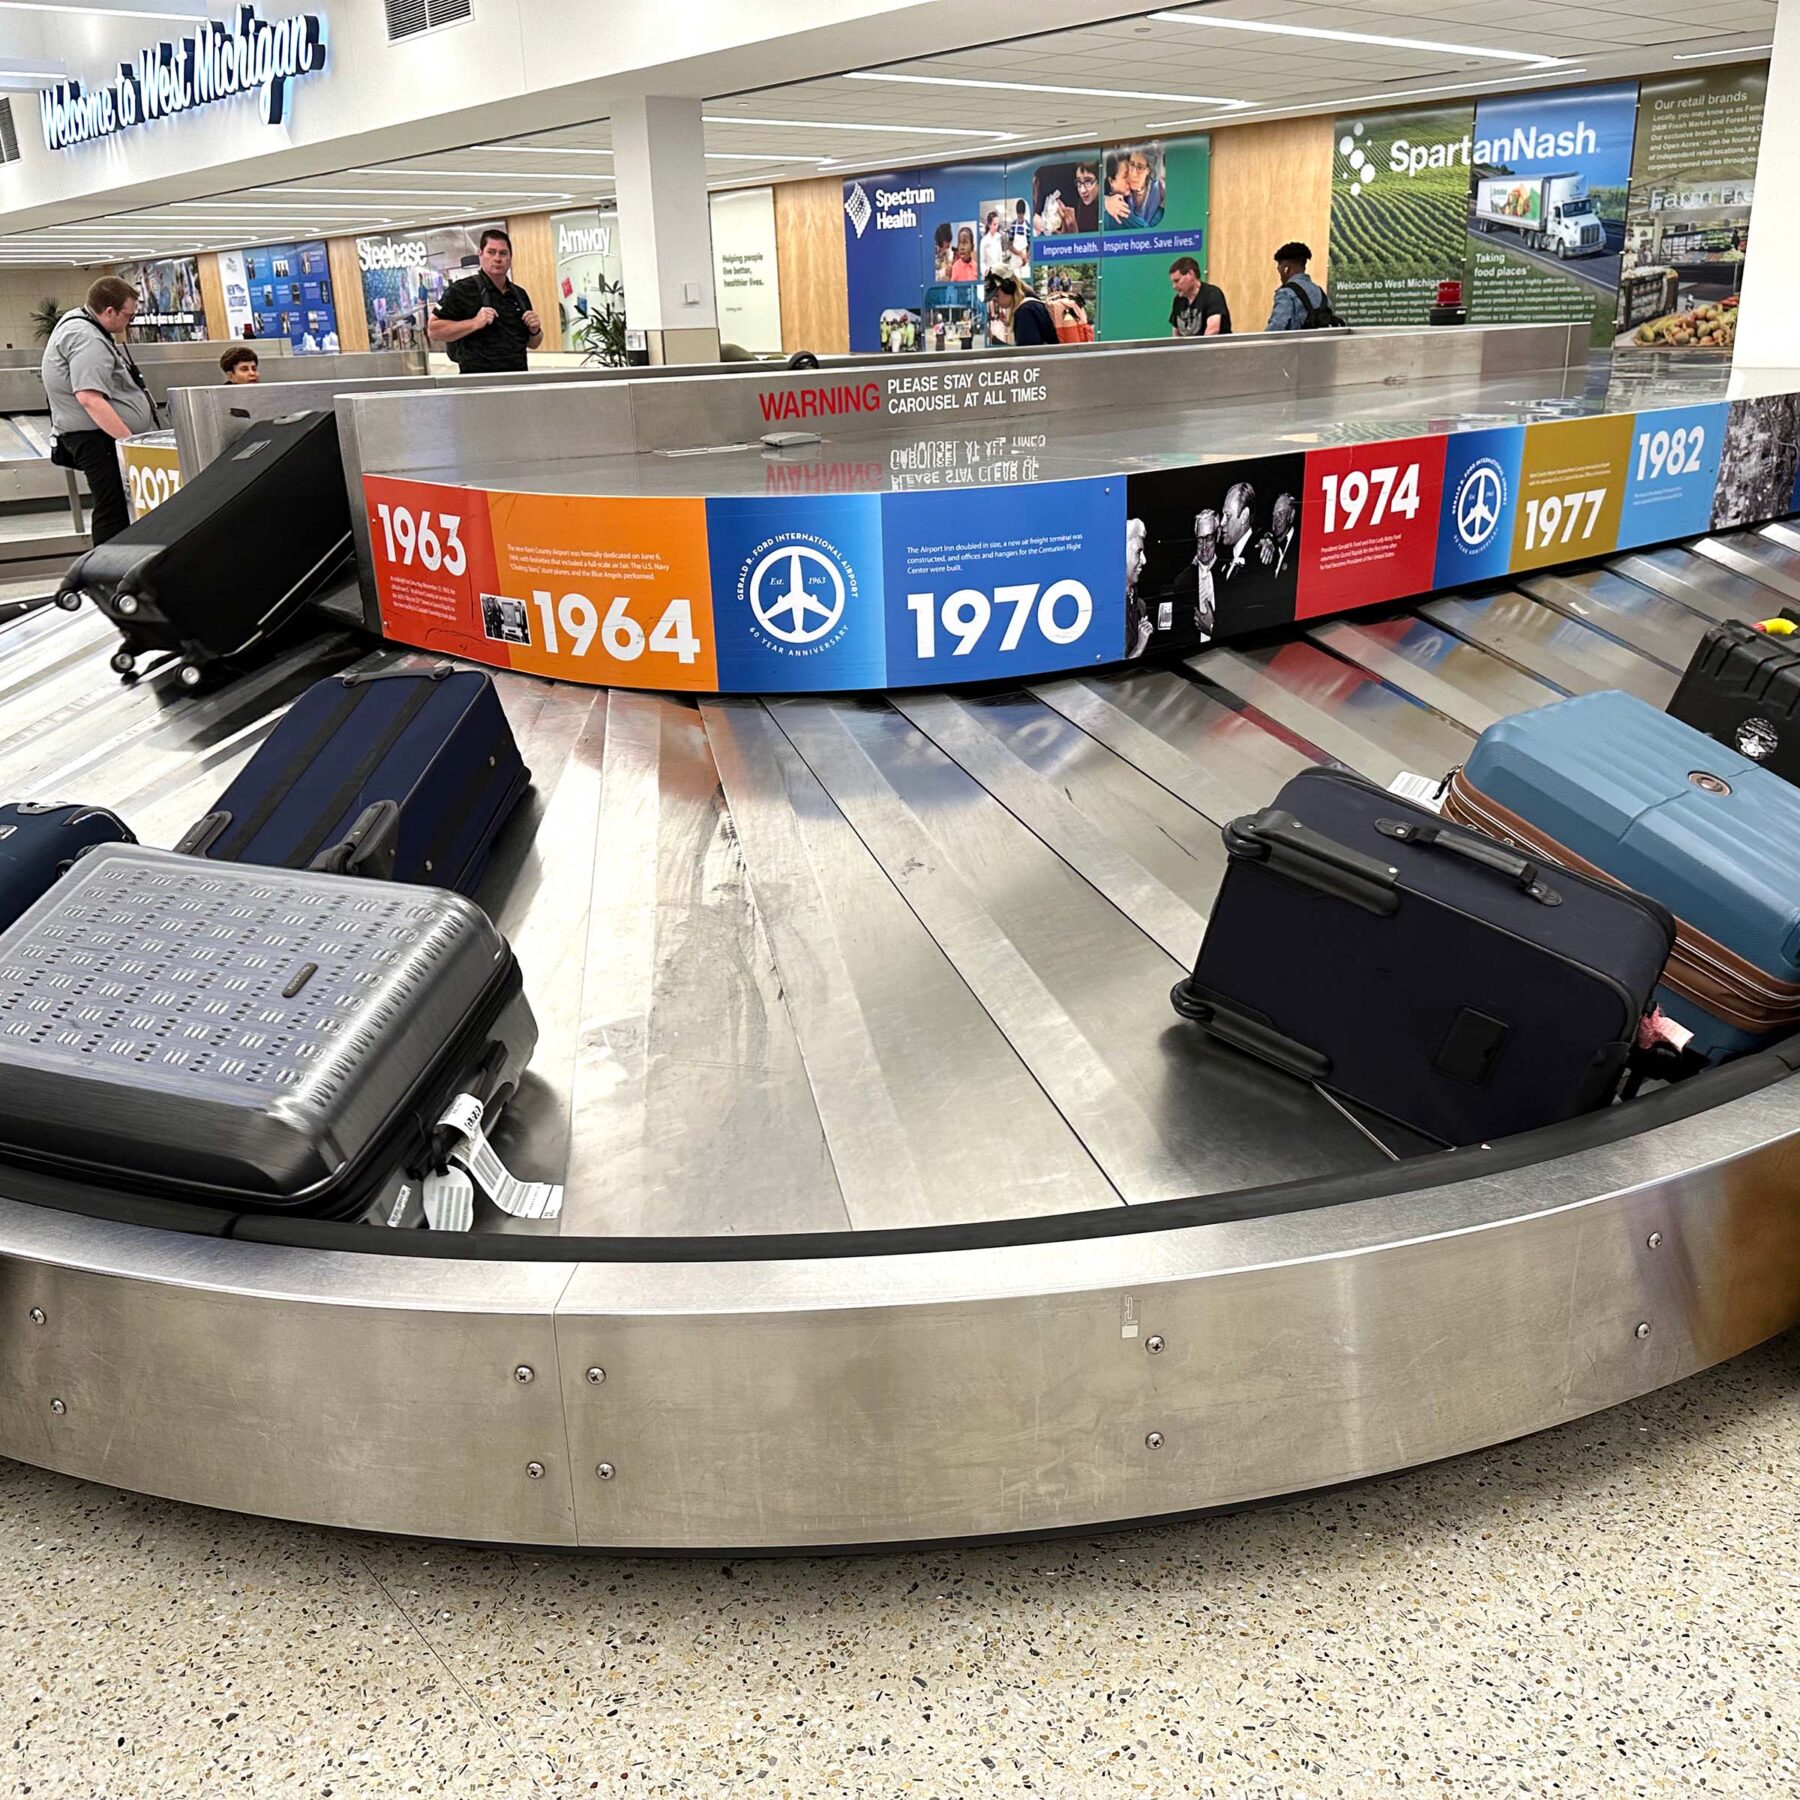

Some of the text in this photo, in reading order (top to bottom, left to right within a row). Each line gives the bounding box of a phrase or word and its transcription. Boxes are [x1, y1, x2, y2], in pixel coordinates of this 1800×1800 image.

[40, 2, 313, 150] Welcome to West Michigan
[1655, 91, 1747, 110] Our retail brands
[1745, 104, 1764, 112] Famil
[1390, 121, 1596, 177] SpartanNash
[876, 188, 935, 211] Spectrum
[876, 208, 916, 230] Health
[559, 224, 611, 256] Amway
[1043, 244, 1073, 256] Improve
[1074, 242, 1099, 253] health.
[1104, 240, 1130, 252] Inspire
[1130, 238, 1152, 251] hope.
[1153, 237, 1172, 248] Save
[356, 237, 427, 271] Steelcase
[722, 252, 763, 264] Helping people
[1476, 254, 1505, 264] Taking
[723, 267, 732, 275] live
[724, 278, 748, 287] healthier
[1474, 267, 1495, 277] food
[1337, 281, 1372, 290] Welcome
[1374, 280, 1383, 288] to
[1385, 279, 1405, 288] West
[888, 368, 1040, 394] PLEASE STAY CLEAR OF
[759, 383, 880, 421] WARNING
[888, 386, 1047, 414] CAROUSEL AT ALL TIMES
[1636, 426, 1704, 480] 1982
[1322, 463, 1420, 534] 1974
[1525, 488, 1607, 551] 1977
[377, 504, 466, 576] 1963
[920, 546, 943, 554] Airport
[956, 542, 981, 551] doubled
[1030, 537, 1048, 545] freight
[1049, 534, 1071, 542] terminal
[907, 556, 946, 564] constructed,
[948, 554, 960, 562] and
[1039, 545, 1065, 554] Centurion
[1066, 543, 1081, 551] Flight
[588, 560, 610, 568] full-scale
[654, 563, 669, 572] Navy
[604, 571, 622, 580] Angels
[737, 532, 858, 600] GERALD R. FORD INTERNATIONAL AIRPORT
[946, 564, 962, 572] built.
[533, 590, 700, 664] 1964
[907, 578, 1093, 659] 1970
[749, 624, 849, 656] 60 YEAR ANNIVERSARY
